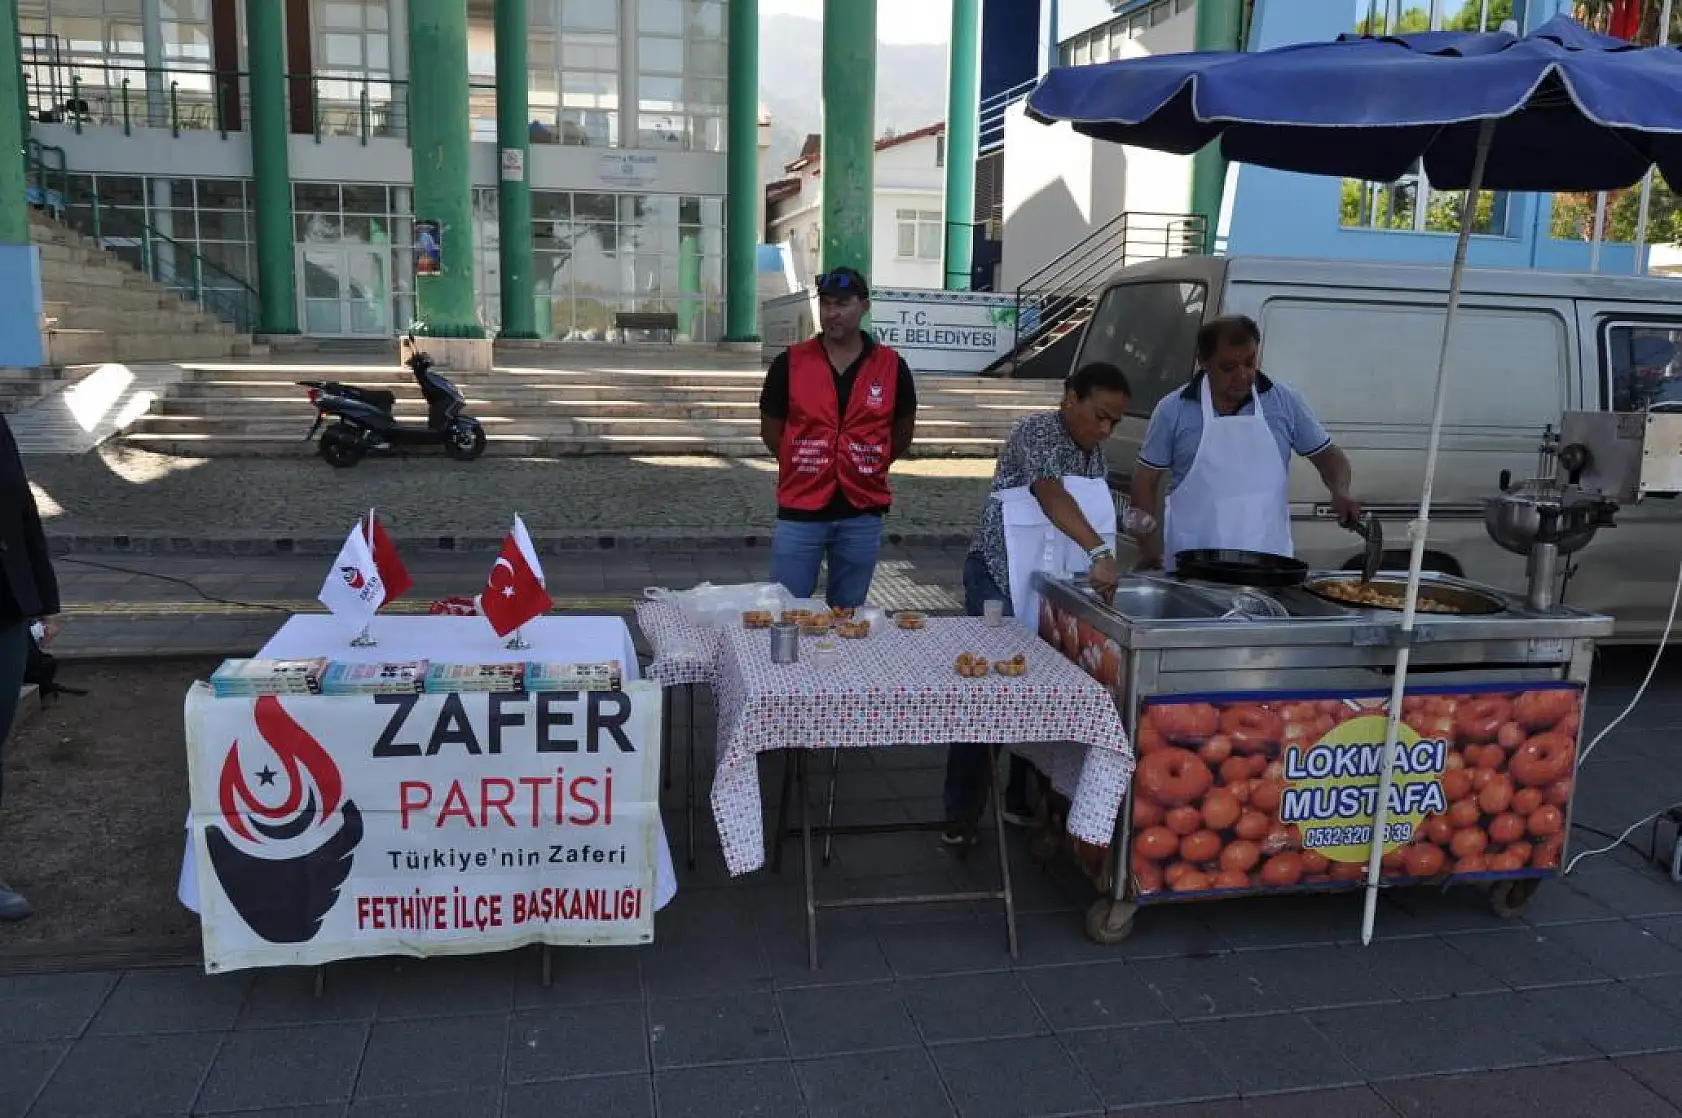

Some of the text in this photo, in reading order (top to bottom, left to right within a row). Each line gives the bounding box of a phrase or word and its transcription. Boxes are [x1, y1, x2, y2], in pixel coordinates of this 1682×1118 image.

[373, 690, 636, 757] ZAFER
[1286, 740, 1445, 779] LOKMACI
[400, 766, 613, 830] PARTİSİ
[1282, 781, 1444, 821] MUSTAFA
[387, 845, 627, 872] Türkiye'nin Zaferi
[357, 884, 642, 932] FETHİYE İLÇE BAŞKANLIĞI
